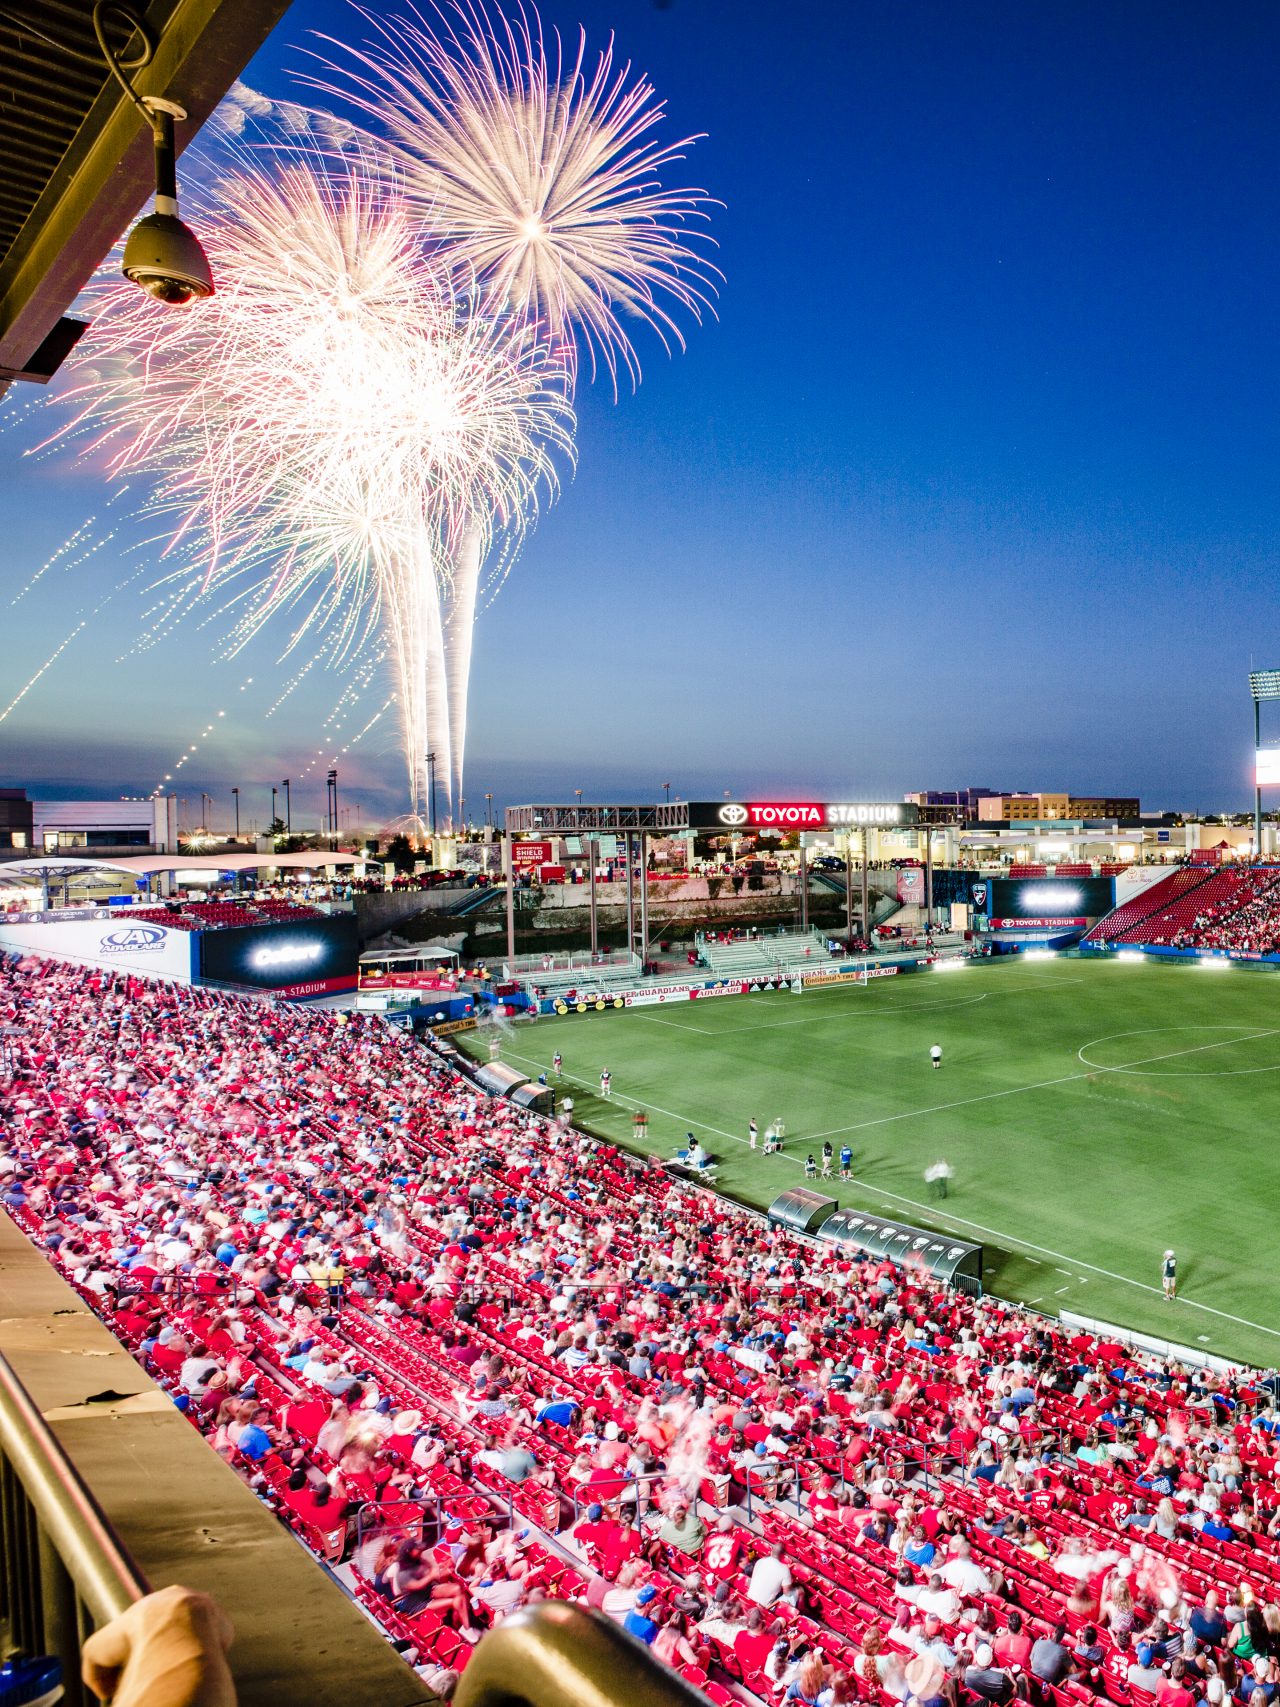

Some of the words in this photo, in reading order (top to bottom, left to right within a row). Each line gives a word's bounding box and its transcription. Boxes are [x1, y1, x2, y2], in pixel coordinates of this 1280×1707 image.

[752, 807, 821, 822] TOYOTA
[828, 806, 898, 823] STADIUM
[100, 942, 166, 953] ADVOCARE
[804, 974, 838, 986] Continental
[290, 982, 326, 996] STADIUM
[639, 985, 690, 996] GUARDIANS
[699, 986, 741, 999] ADVOCARE
